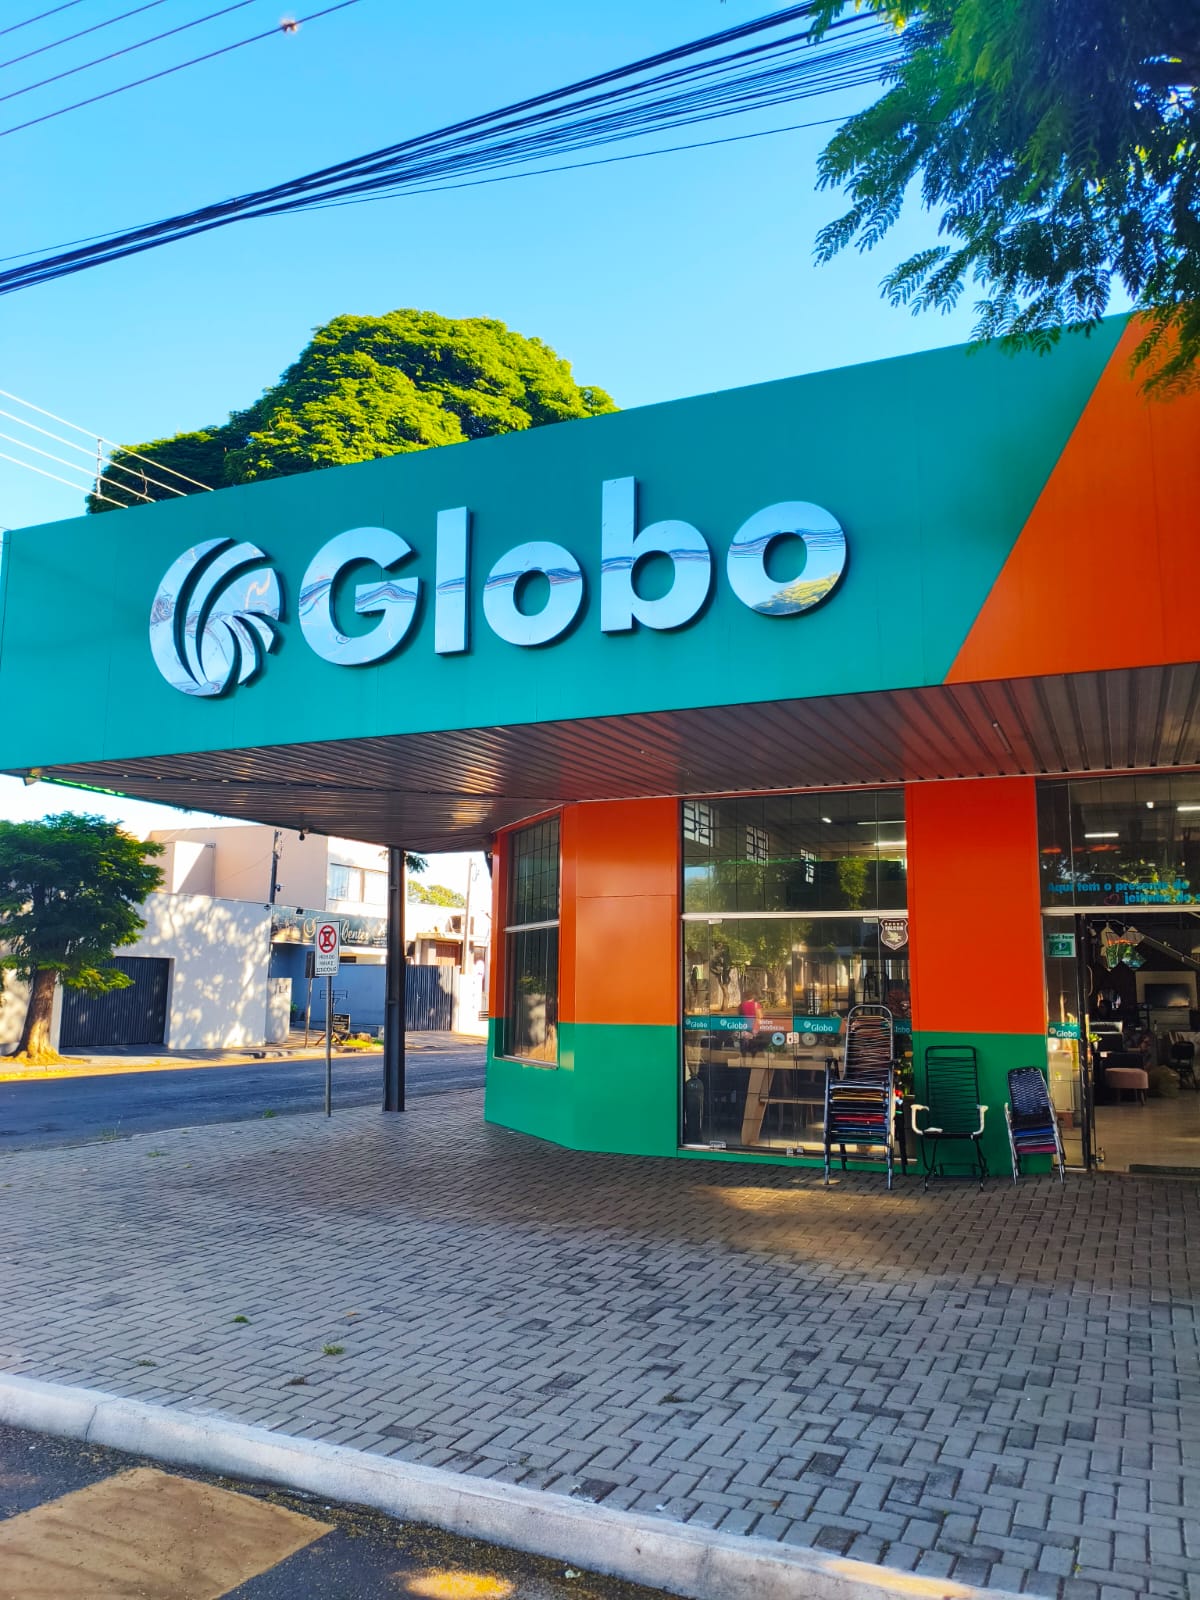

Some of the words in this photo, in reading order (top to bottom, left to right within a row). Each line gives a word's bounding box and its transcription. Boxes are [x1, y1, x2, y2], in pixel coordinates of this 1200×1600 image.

[299, 475, 848, 668] Globo
[1048, 882, 1074, 894] Aqui
[1077, 882, 1100, 892] tem
[1104, 883, 1112, 891] o
[726, 1021, 748, 1030] Globo
[811, 1022, 833, 1032] Globo
[1056, 1029, 1078, 1038] Globo
